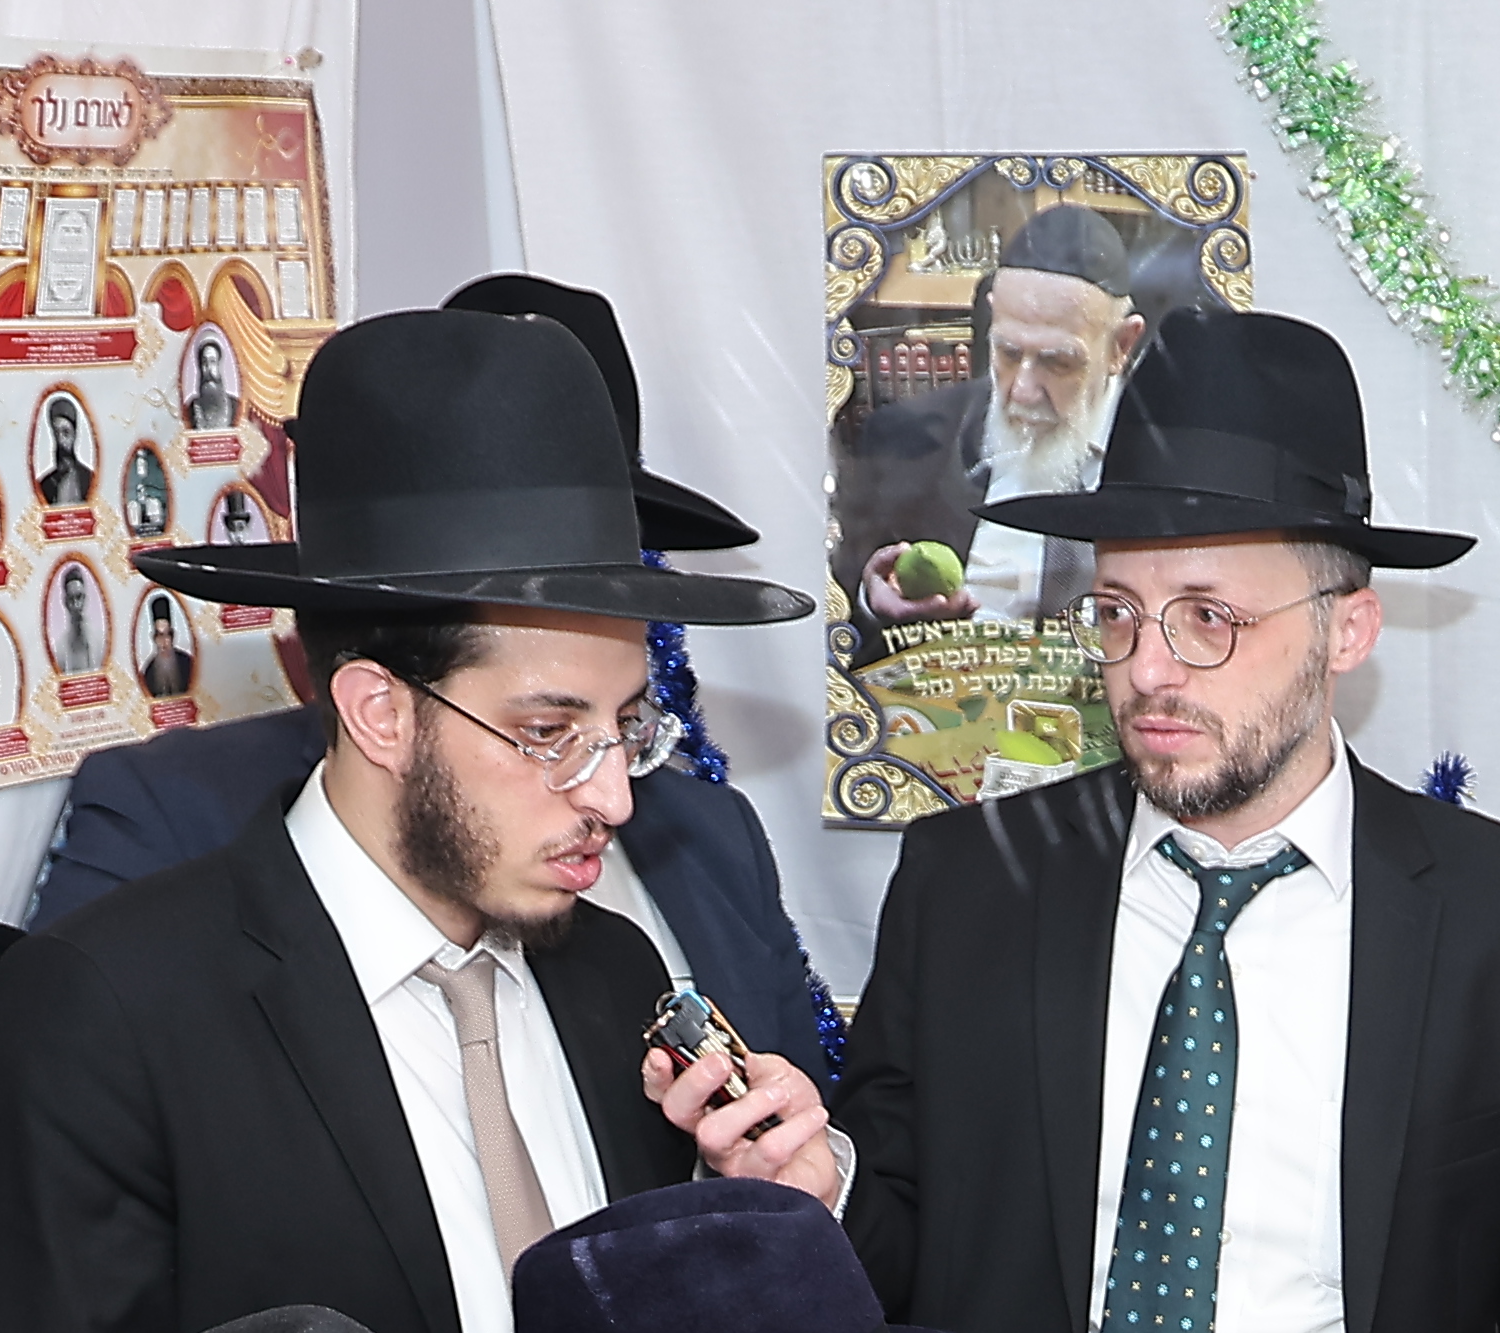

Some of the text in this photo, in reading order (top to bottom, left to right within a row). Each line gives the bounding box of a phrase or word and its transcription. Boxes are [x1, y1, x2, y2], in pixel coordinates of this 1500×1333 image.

[31, 87, 133, 137] לאורם נלך
[882, 618, 975, 653] הראשון
[982, 618, 1036, 638] ביום
[905, 645, 1084, 671] הדר כפת תמרים
[911, 672, 955, 697] נחל
[961, 673, 1021, 694] וערבי
[1027, 673, 1073, 694] עבת
